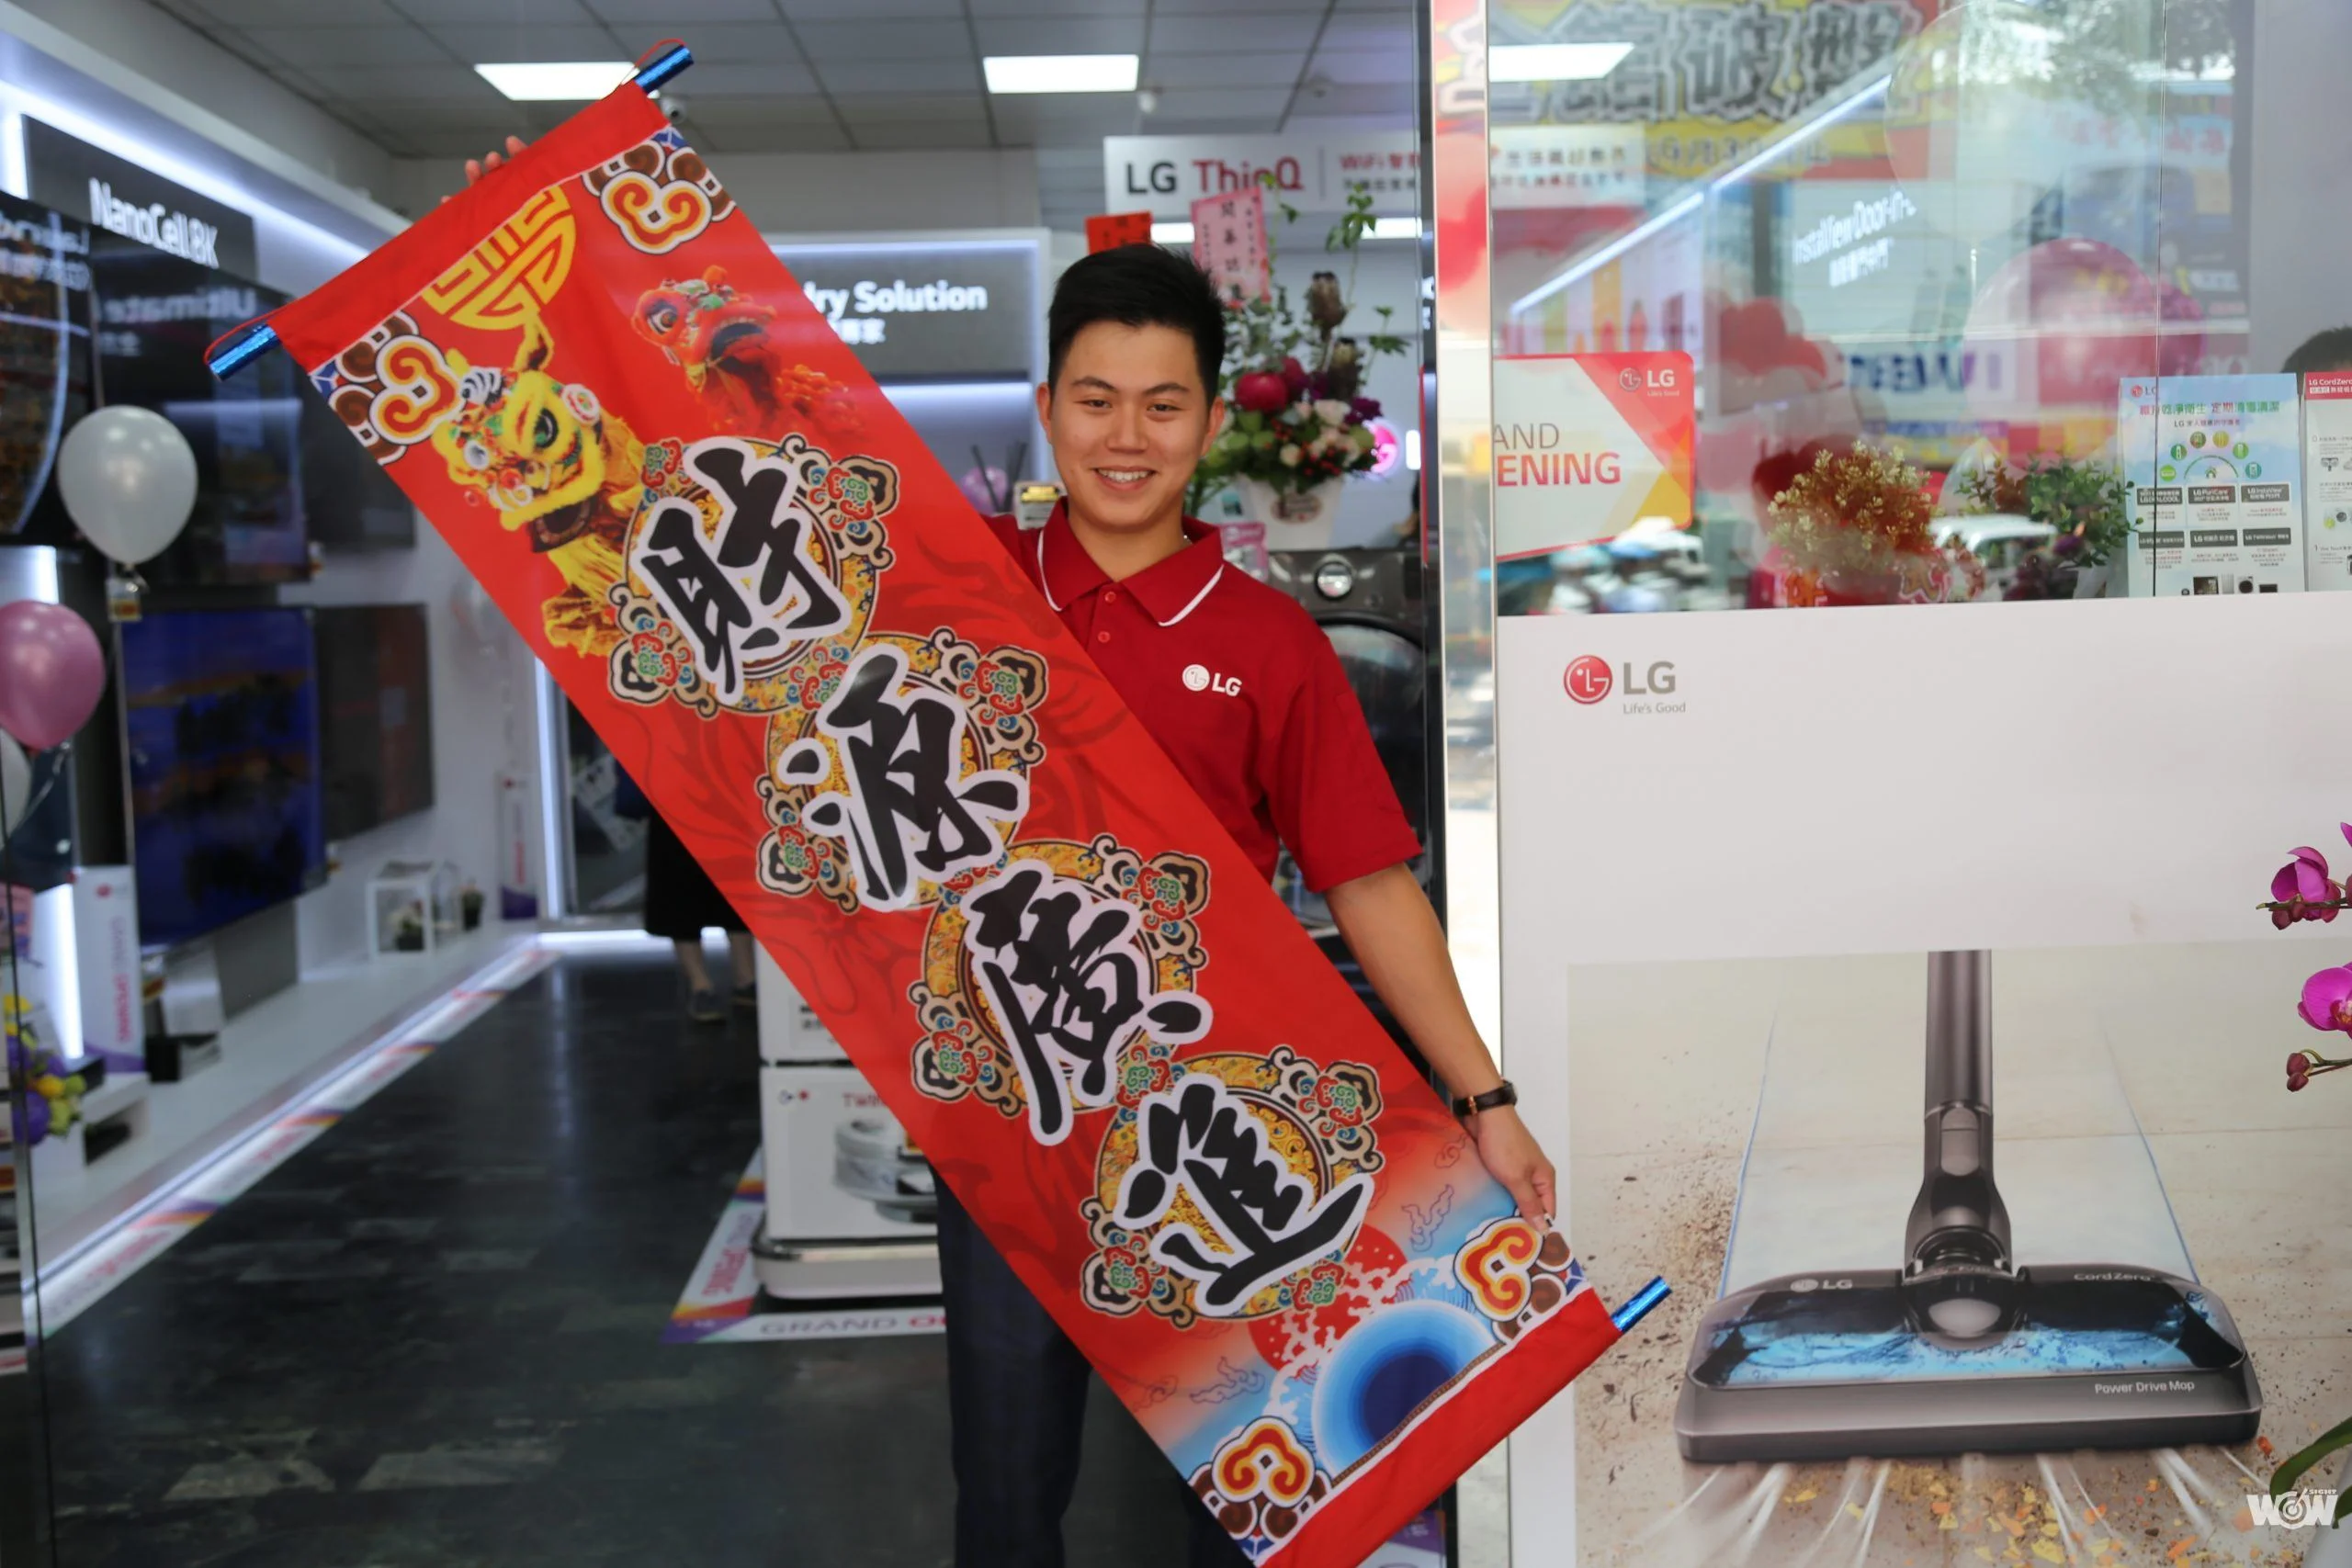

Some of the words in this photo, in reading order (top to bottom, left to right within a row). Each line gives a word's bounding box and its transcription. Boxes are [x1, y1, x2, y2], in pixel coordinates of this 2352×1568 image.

[1126, 161, 1177, 195] LG
[1192, 155, 1304, 192] ThinQ
[89, 177, 188, 258] NanoCell
[188, 217, 220, 269] 8K
[854, 278, 989, 313] Solution
[1646, 369, 1675, 388] LG
[1494, 423, 1559, 451] AND
[1497, 451, 1622, 487] ENING
[1211, 672, 1243, 697] LG
[1623, 660, 1677, 694] LG
[1623, 703, 1652, 715] Life's
[1656, 702, 1686, 714] Good
[1822, 1279, 1853, 1290] LG
[2074, 1272, 2152, 1281] CordZero
[760, 1316, 898, 1336] GRAND
[2095, 1382, 2132, 1394] Power
[2135, 1381, 2167, 1392] Drive
[2169, 1380, 2195, 1392] Mop
